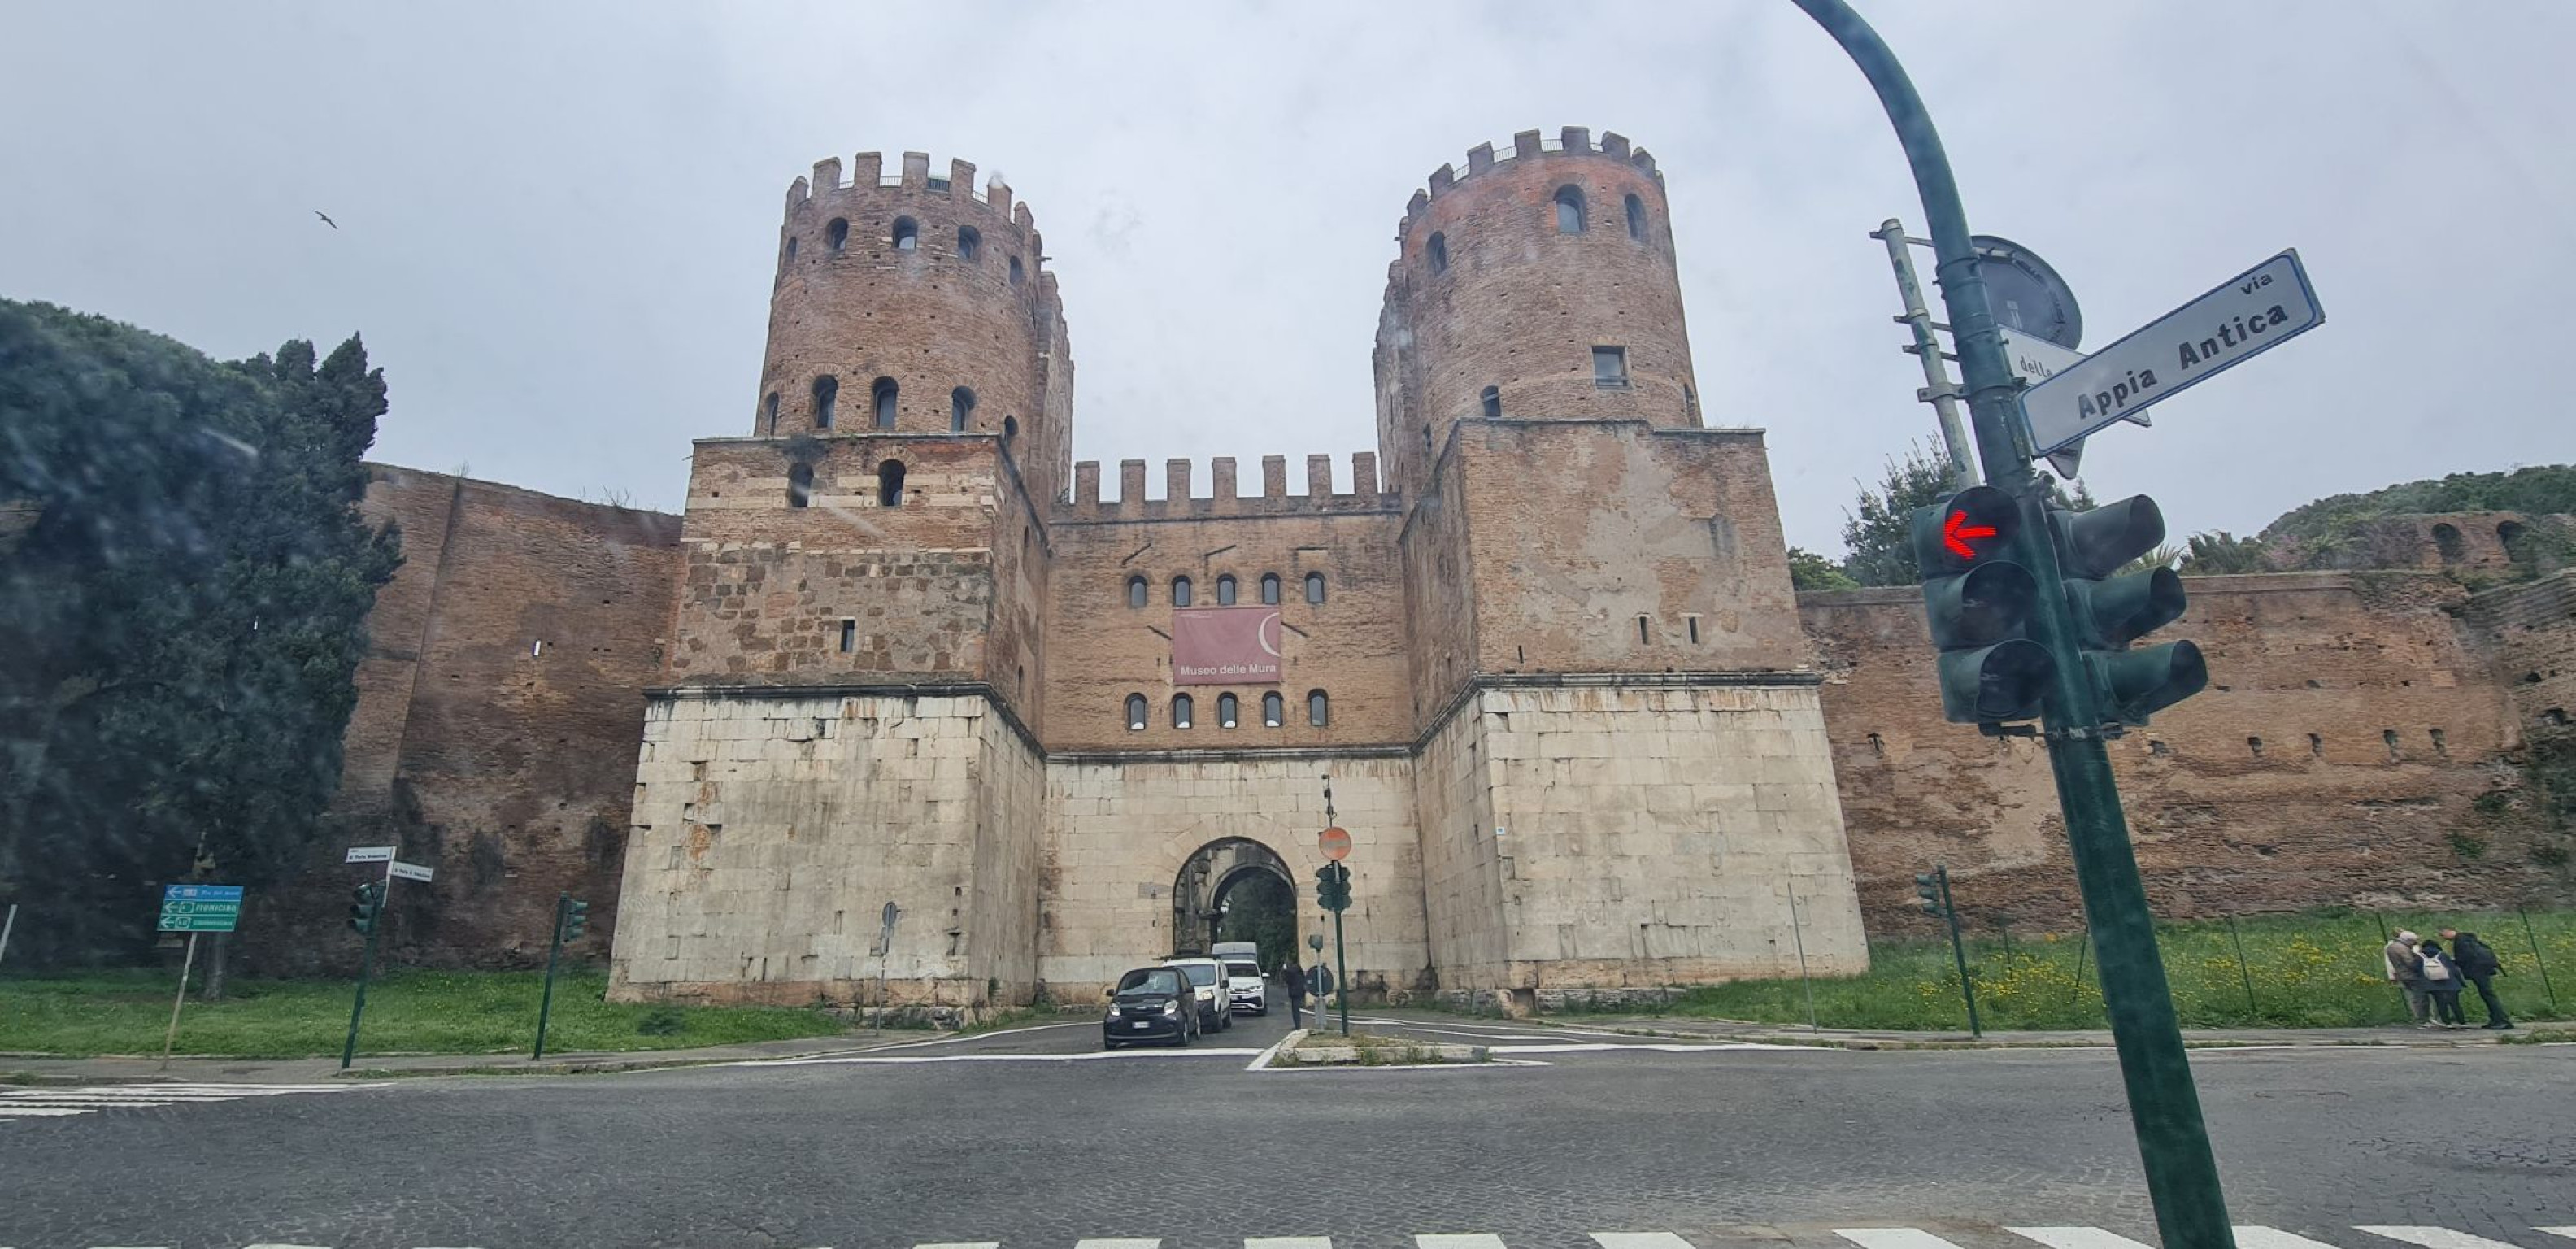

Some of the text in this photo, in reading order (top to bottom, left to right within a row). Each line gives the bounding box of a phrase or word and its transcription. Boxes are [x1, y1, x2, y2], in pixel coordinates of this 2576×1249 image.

[2240, 273, 2274, 294] via
[2077, 304, 2288, 420] Appia Antica
[1181, 664, 1276, 676] Museo delle Mura
